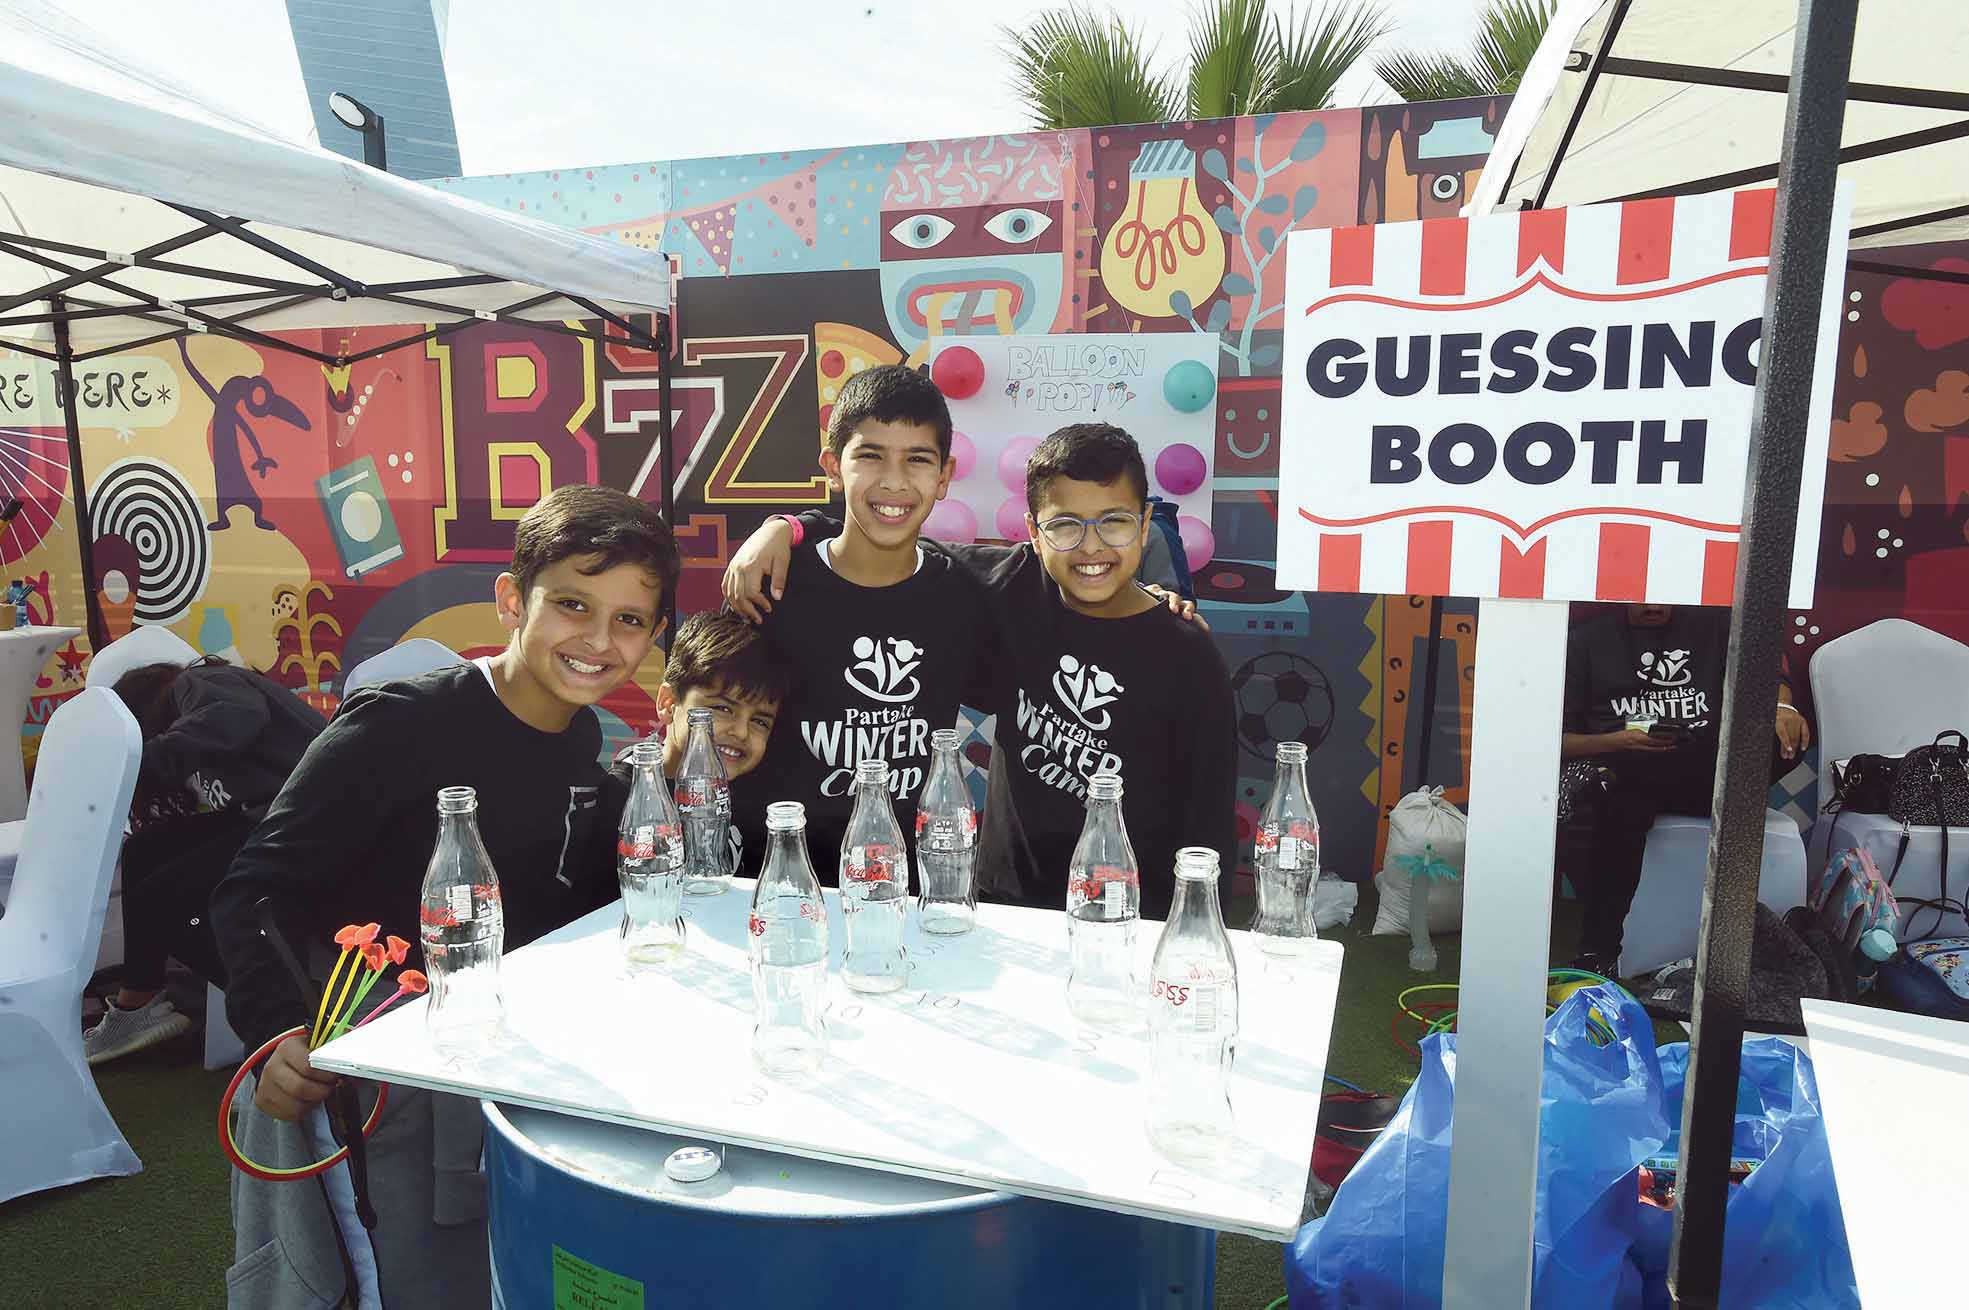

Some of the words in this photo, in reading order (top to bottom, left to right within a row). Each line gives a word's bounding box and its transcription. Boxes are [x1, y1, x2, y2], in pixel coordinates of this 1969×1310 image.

[1007, 344, 1146, 381] BALLOON
[1369, 418, 1708, 485] BOOTH
[844, 704, 915, 727] Partake
[1038, 702, 1109, 750] Partake
[1610, 690, 1710, 719] WINTER
[800, 718, 929, 769] WINTER
[1016, 687, 1123, 782] WNTER
[1020, 743, 1091, 806] Cam
[917, 992, 961, 1010] 10
